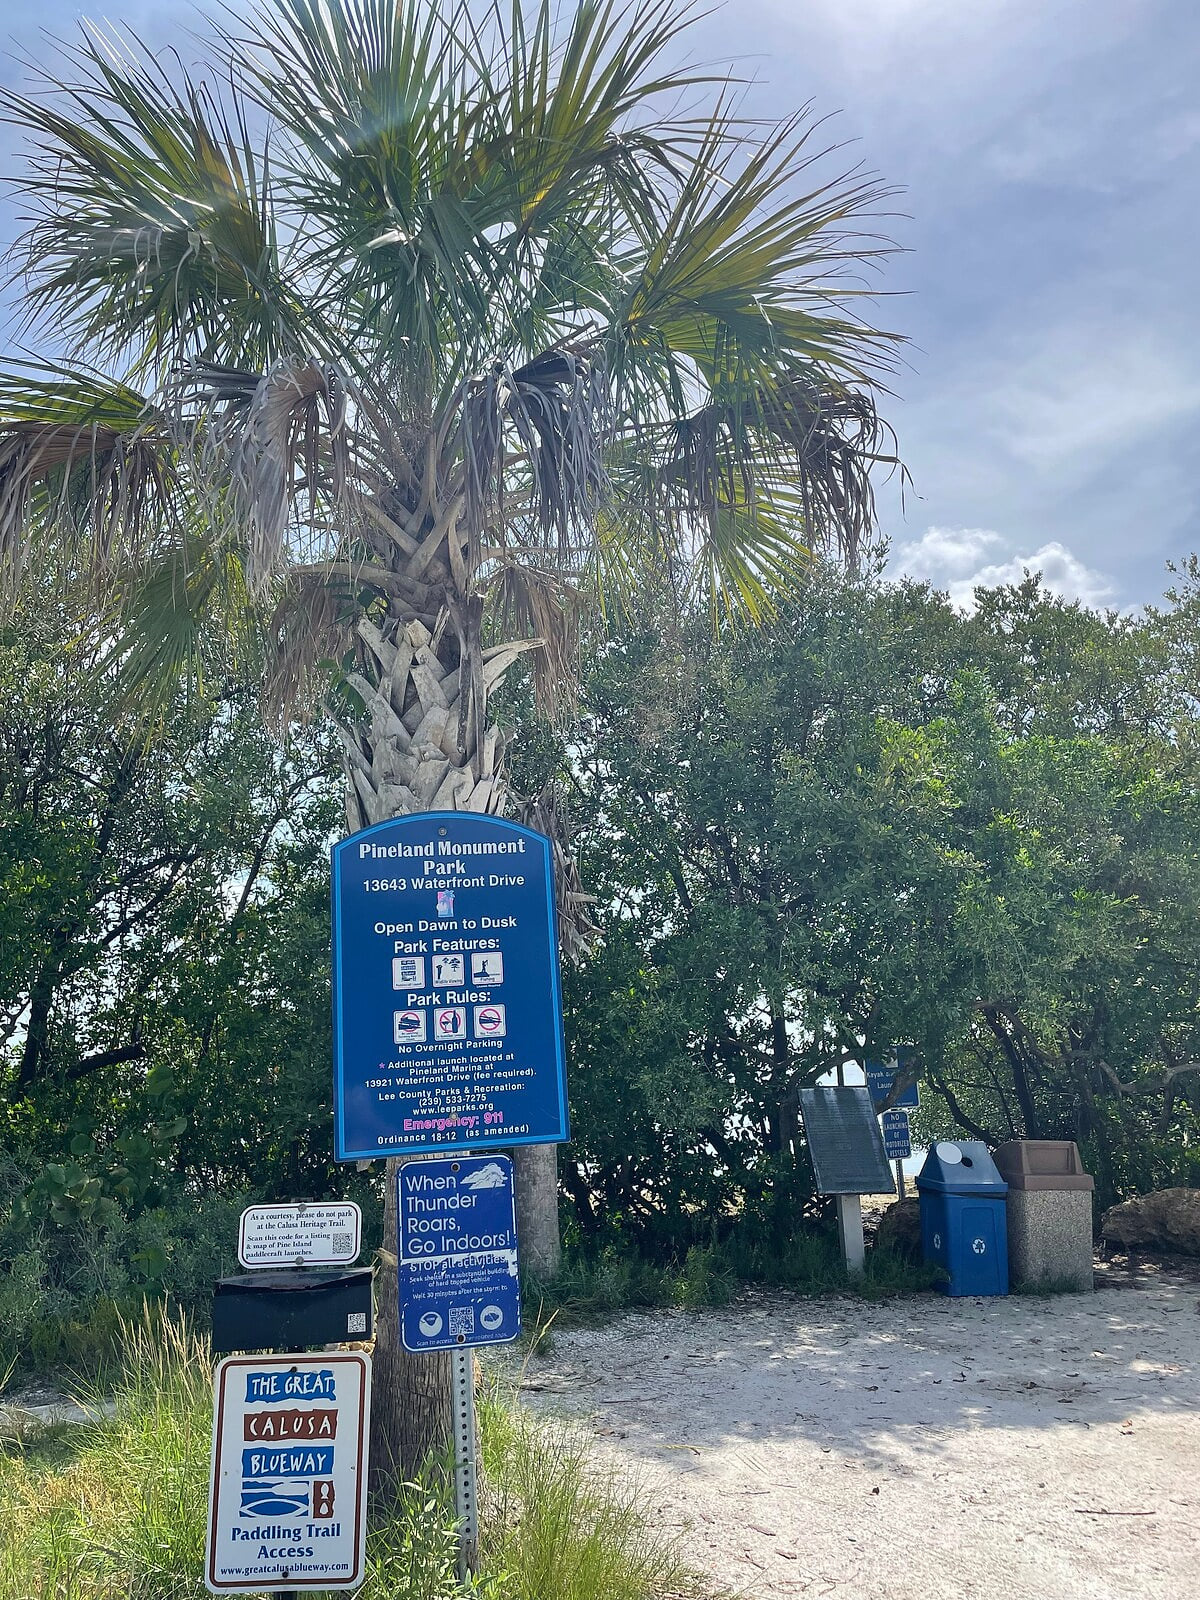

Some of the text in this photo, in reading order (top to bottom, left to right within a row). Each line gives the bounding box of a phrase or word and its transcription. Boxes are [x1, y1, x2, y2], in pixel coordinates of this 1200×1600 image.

[360, 838, 526, 858] Pineland Monument
[424, 860, 466, 875] Park
[363, 874, 524, 892] 13643 Waterfront Drive
[374, 916, 517, 936] Open Dawn to Dusk
[394, 938, 500, 953] Park Features:
[407, 990, 491, 1006] Park Rules:
[398, 1040, 503, 1054] No Overnight Parking
[388, 1058, 434, 1069] Additional
[438, 1056, 467, 1066] launch
[470, 1054, 502, 1063] located
[409, 1066, 449, 1076] Pineland
[452, 1064, 482, 1073] Marina
[866, 1071, 884, 1079] Kayak
[365, 1068, 537, 1088] 13921 Waterfront Drive (fee required).
[379, 1092, 395, 1101] Lee
[399, 1090, 431, 1100] County
[435, 1087, 460, 1096] Parks
[474, 1083, 525, 1093] Recreation:
[419, 1093, 487, 1107] (239) 533-7275
[413, 1102, 494, 1116] www.leeparks.org
[403, 1111, 504, 1131] Emergency: 911
[377, 1124, 529, 1145] Ordinance 18-12 (as amended)
[886, 1140, 909, 1148] MOTORIZED
[890, 1149, 908, 1157] VESSELS
[406, 1175, 456, 1192] When
[406, 1193, 477, 1213] Thunder
[296, 1211, 315, 1219] please
[338, 1210, 352, 1218] park
[300, 1220, 327, 1229] Heritage
[408, 1217, 460, 1234] Roars,
[310, 1232, 330, 1240] listing
[408, 1230, 510, 1254] Go Indoors!
[245, 1250, 282, 1259] paddlecraft
[409, 1261, 439, 1272] STOP
[442, 1257, 455, 1269] all
[424, 1273, 444, 1281] shelter
[456, 1269, 486, 1278] substantial
[450, 1279, 470, 1287] topped
[252, 1375, 332, 1395] THE GREAT
[250, 1415, 332, 1436] CALUSA
[251, 1453, 327, 1475] BLUEWAY
[231, 1523, 340, 1541] Paddling Trail
[257, 1545, 314, 1559] Access
[220, 1562, 349, 1576] www.greatcalusablueway.com
